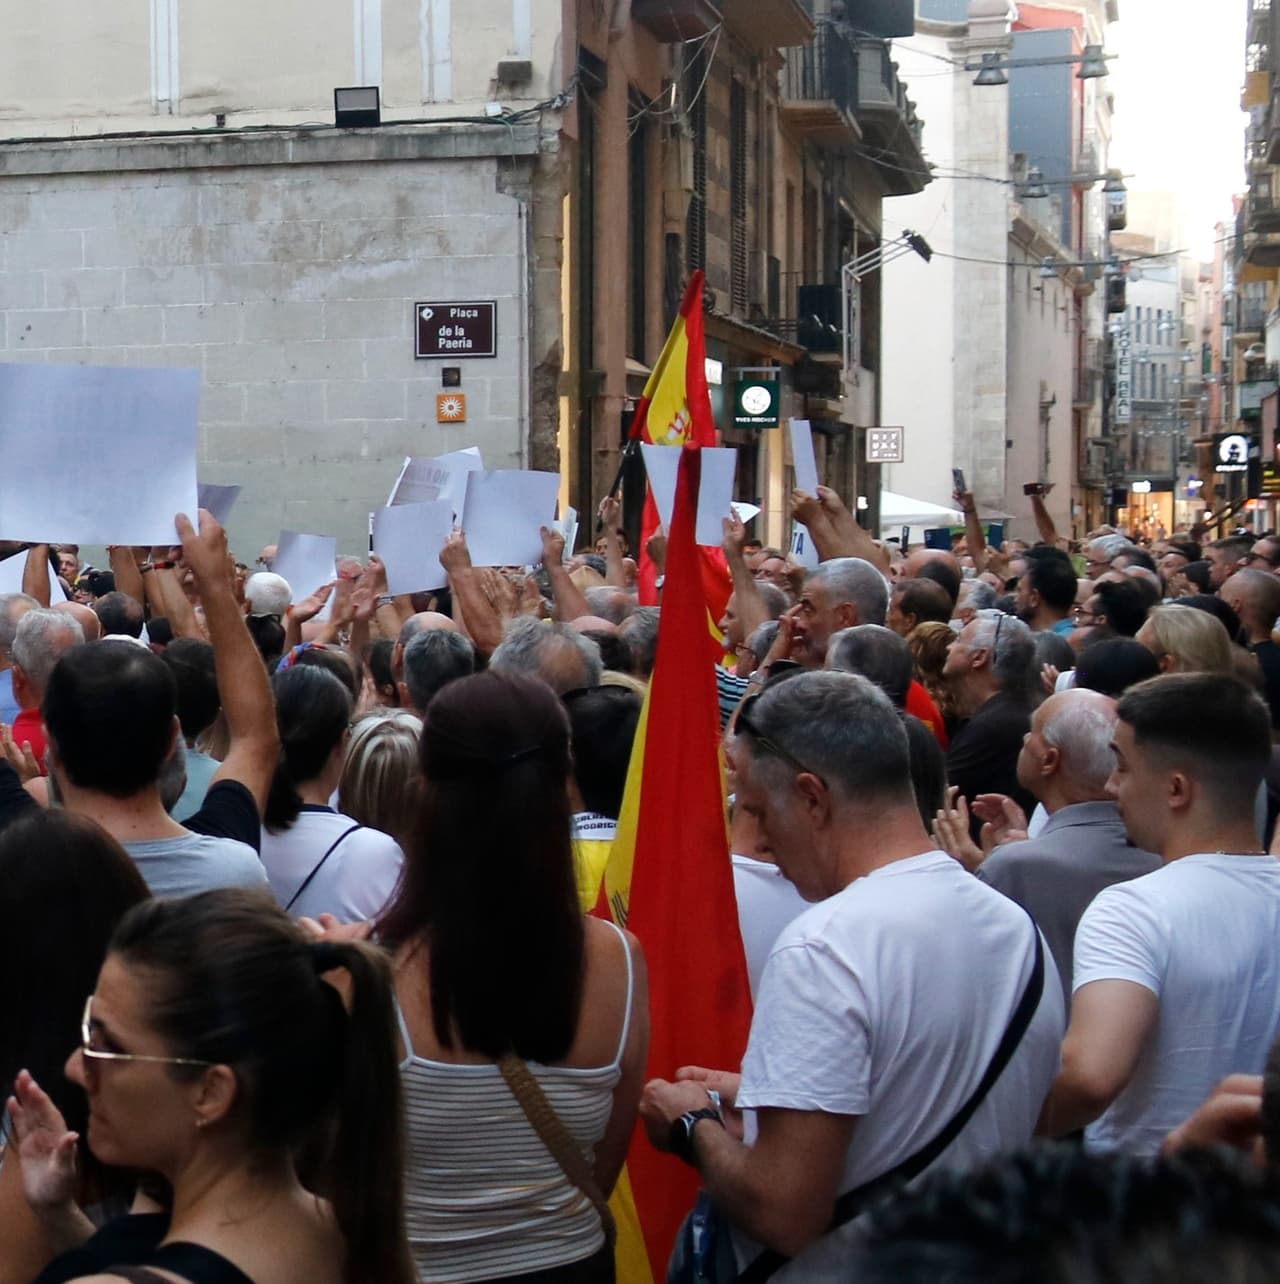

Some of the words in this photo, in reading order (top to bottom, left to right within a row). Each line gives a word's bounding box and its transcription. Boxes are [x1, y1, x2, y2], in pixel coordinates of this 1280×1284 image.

[450, 308, 478, 318] Plaça
[439, 325, 452, 336] de
[455, 325, 464, 336] la
[439, 337, 472, 349] Paeria
[1119, 381, 1128, 416] REAL
